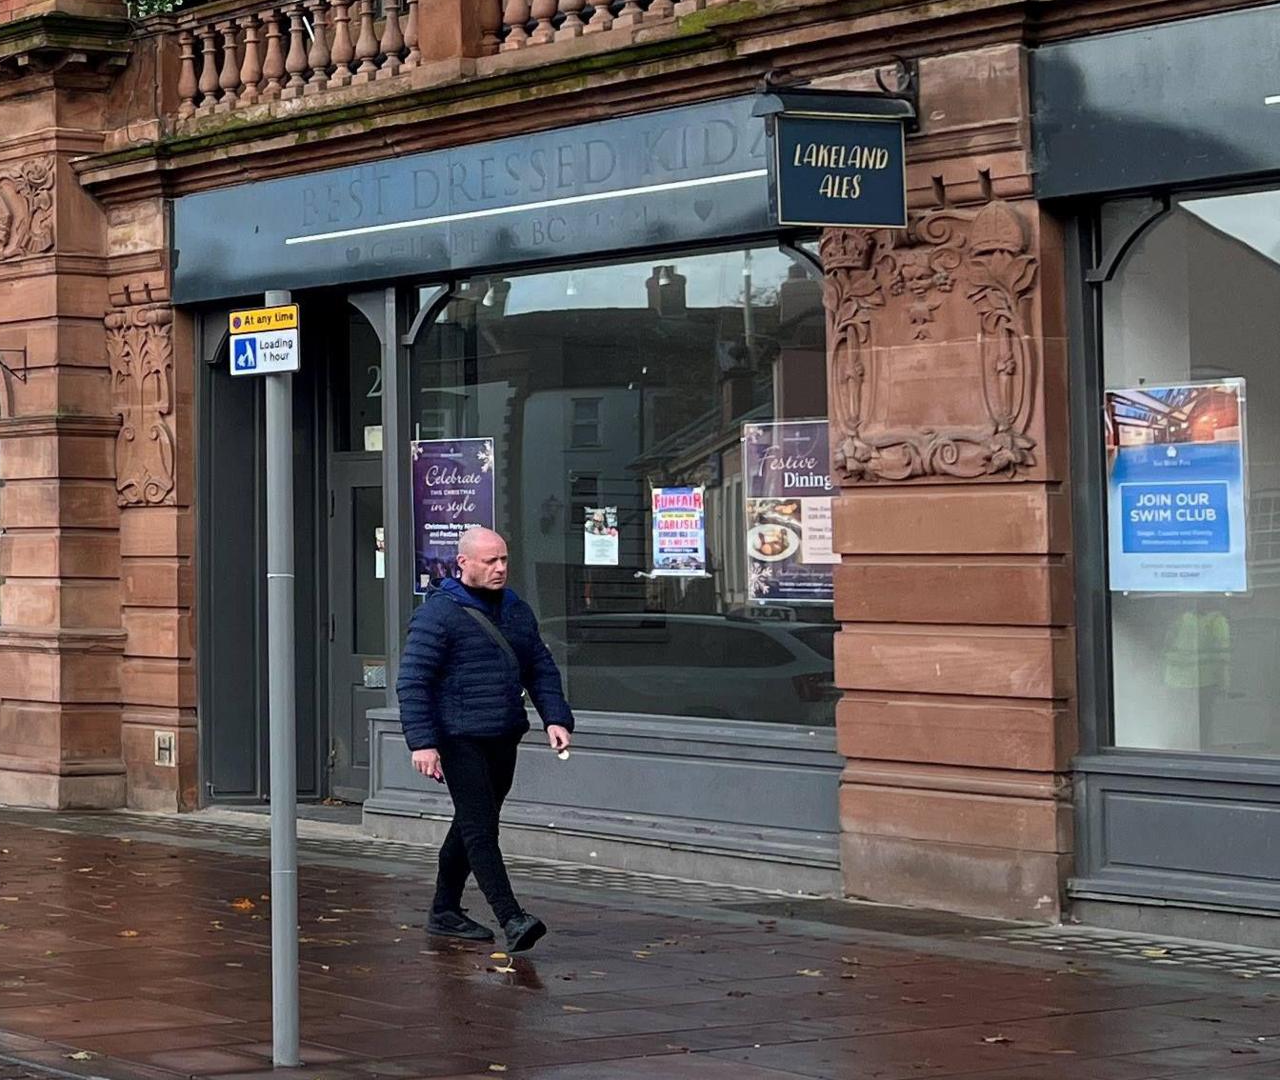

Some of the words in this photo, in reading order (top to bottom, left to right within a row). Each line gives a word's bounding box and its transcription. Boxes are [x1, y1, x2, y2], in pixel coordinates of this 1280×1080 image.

[794, 143, 889, 169] LAKELAND
[819, 174, 862, 198] ALES
[245, 315, 255, 325] At
[257, 316, 272, 325] any
[275, 312, 293, 322] time
[259, 338, 293, 350] Loading
[269, 351, 290, 362] hour
[758, 444, 818, 477] Festive
[425, 465, 481, 487] Celebrate
[783, 471, 834, 491] Dining
[430, 502, 444, 512] in
[446, 496, 477, 519] style
[654, 493, 702, 510] FUNFAIR
[1135, 493, 1172, 507] JOIN
[1176, 492, 1209, 506] OUR
[657, 519, 698, 530] CARLISLE
[1130, 509, 1172, 523] SWIM
[1175, 508, 1217, 522] CLUB
[157, 735, 172, 763] H
